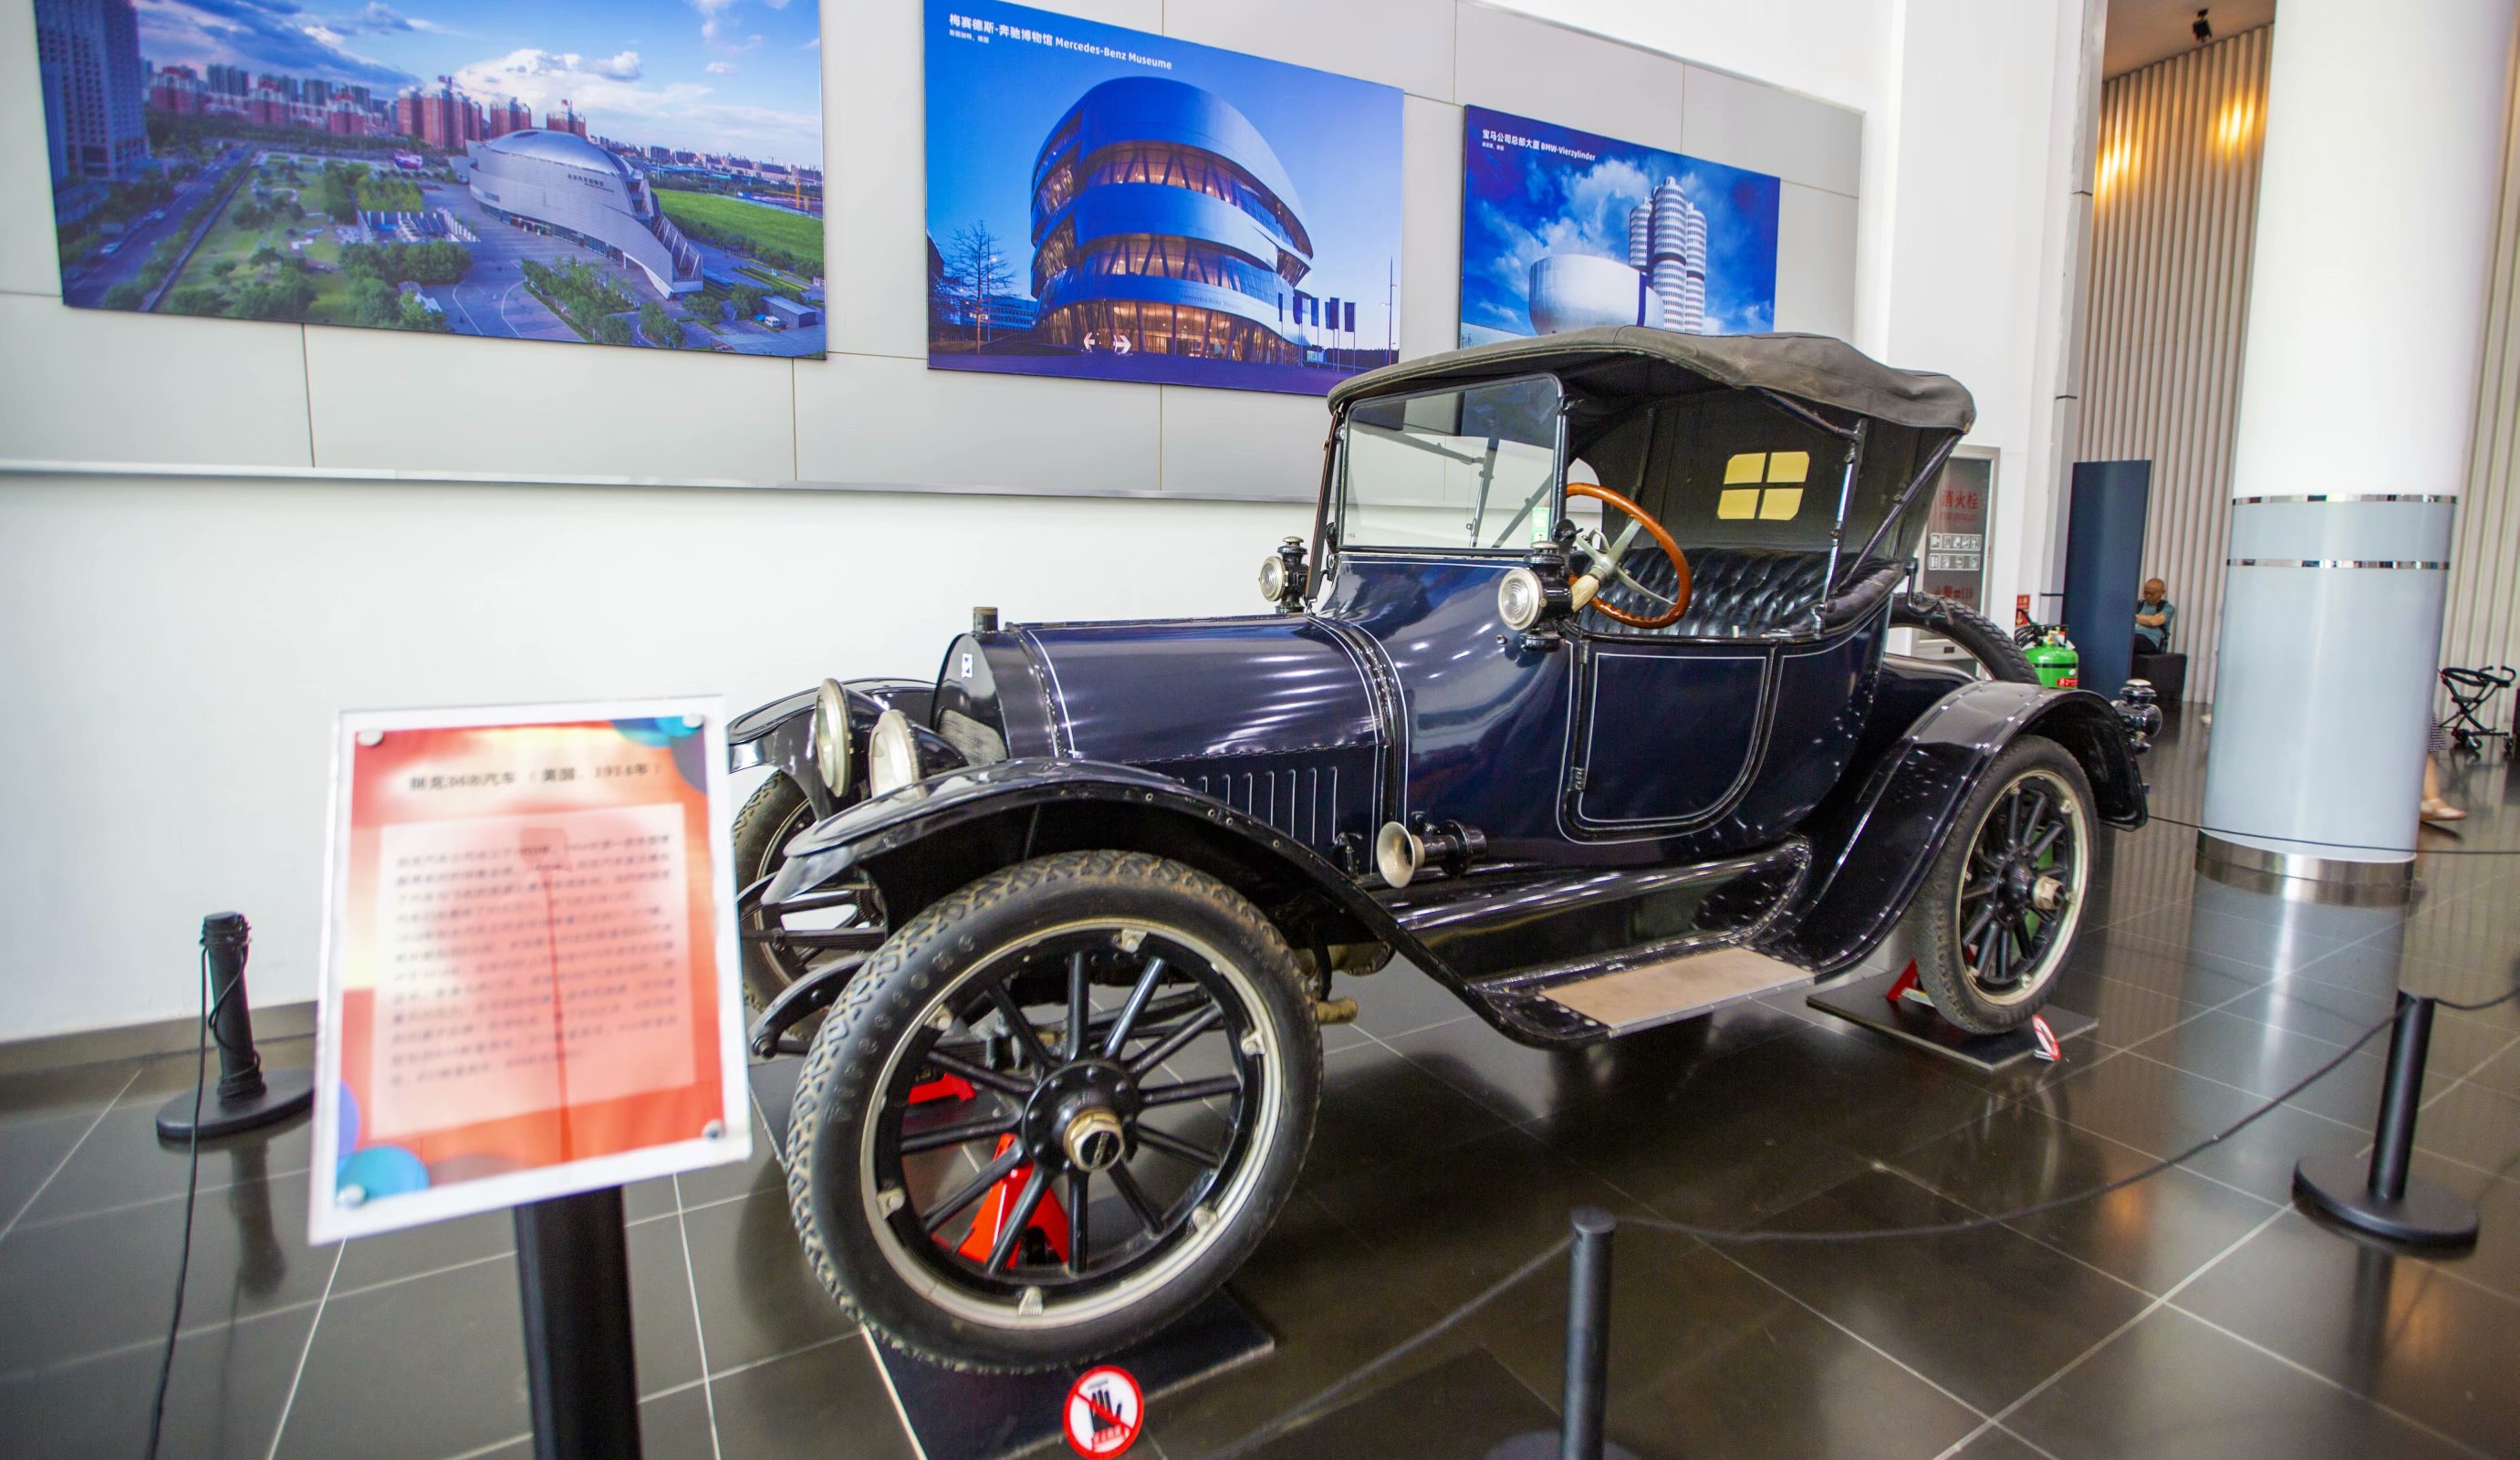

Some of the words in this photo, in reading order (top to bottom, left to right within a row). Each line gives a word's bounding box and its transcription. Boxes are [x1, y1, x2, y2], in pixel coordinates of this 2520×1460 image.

[1055, 36, 1128, 61] Mercedes-Benz
[1128, 52, 1173, 70] Museume
[1540, 143, 1596, 162] BMW-Vierzylinder
